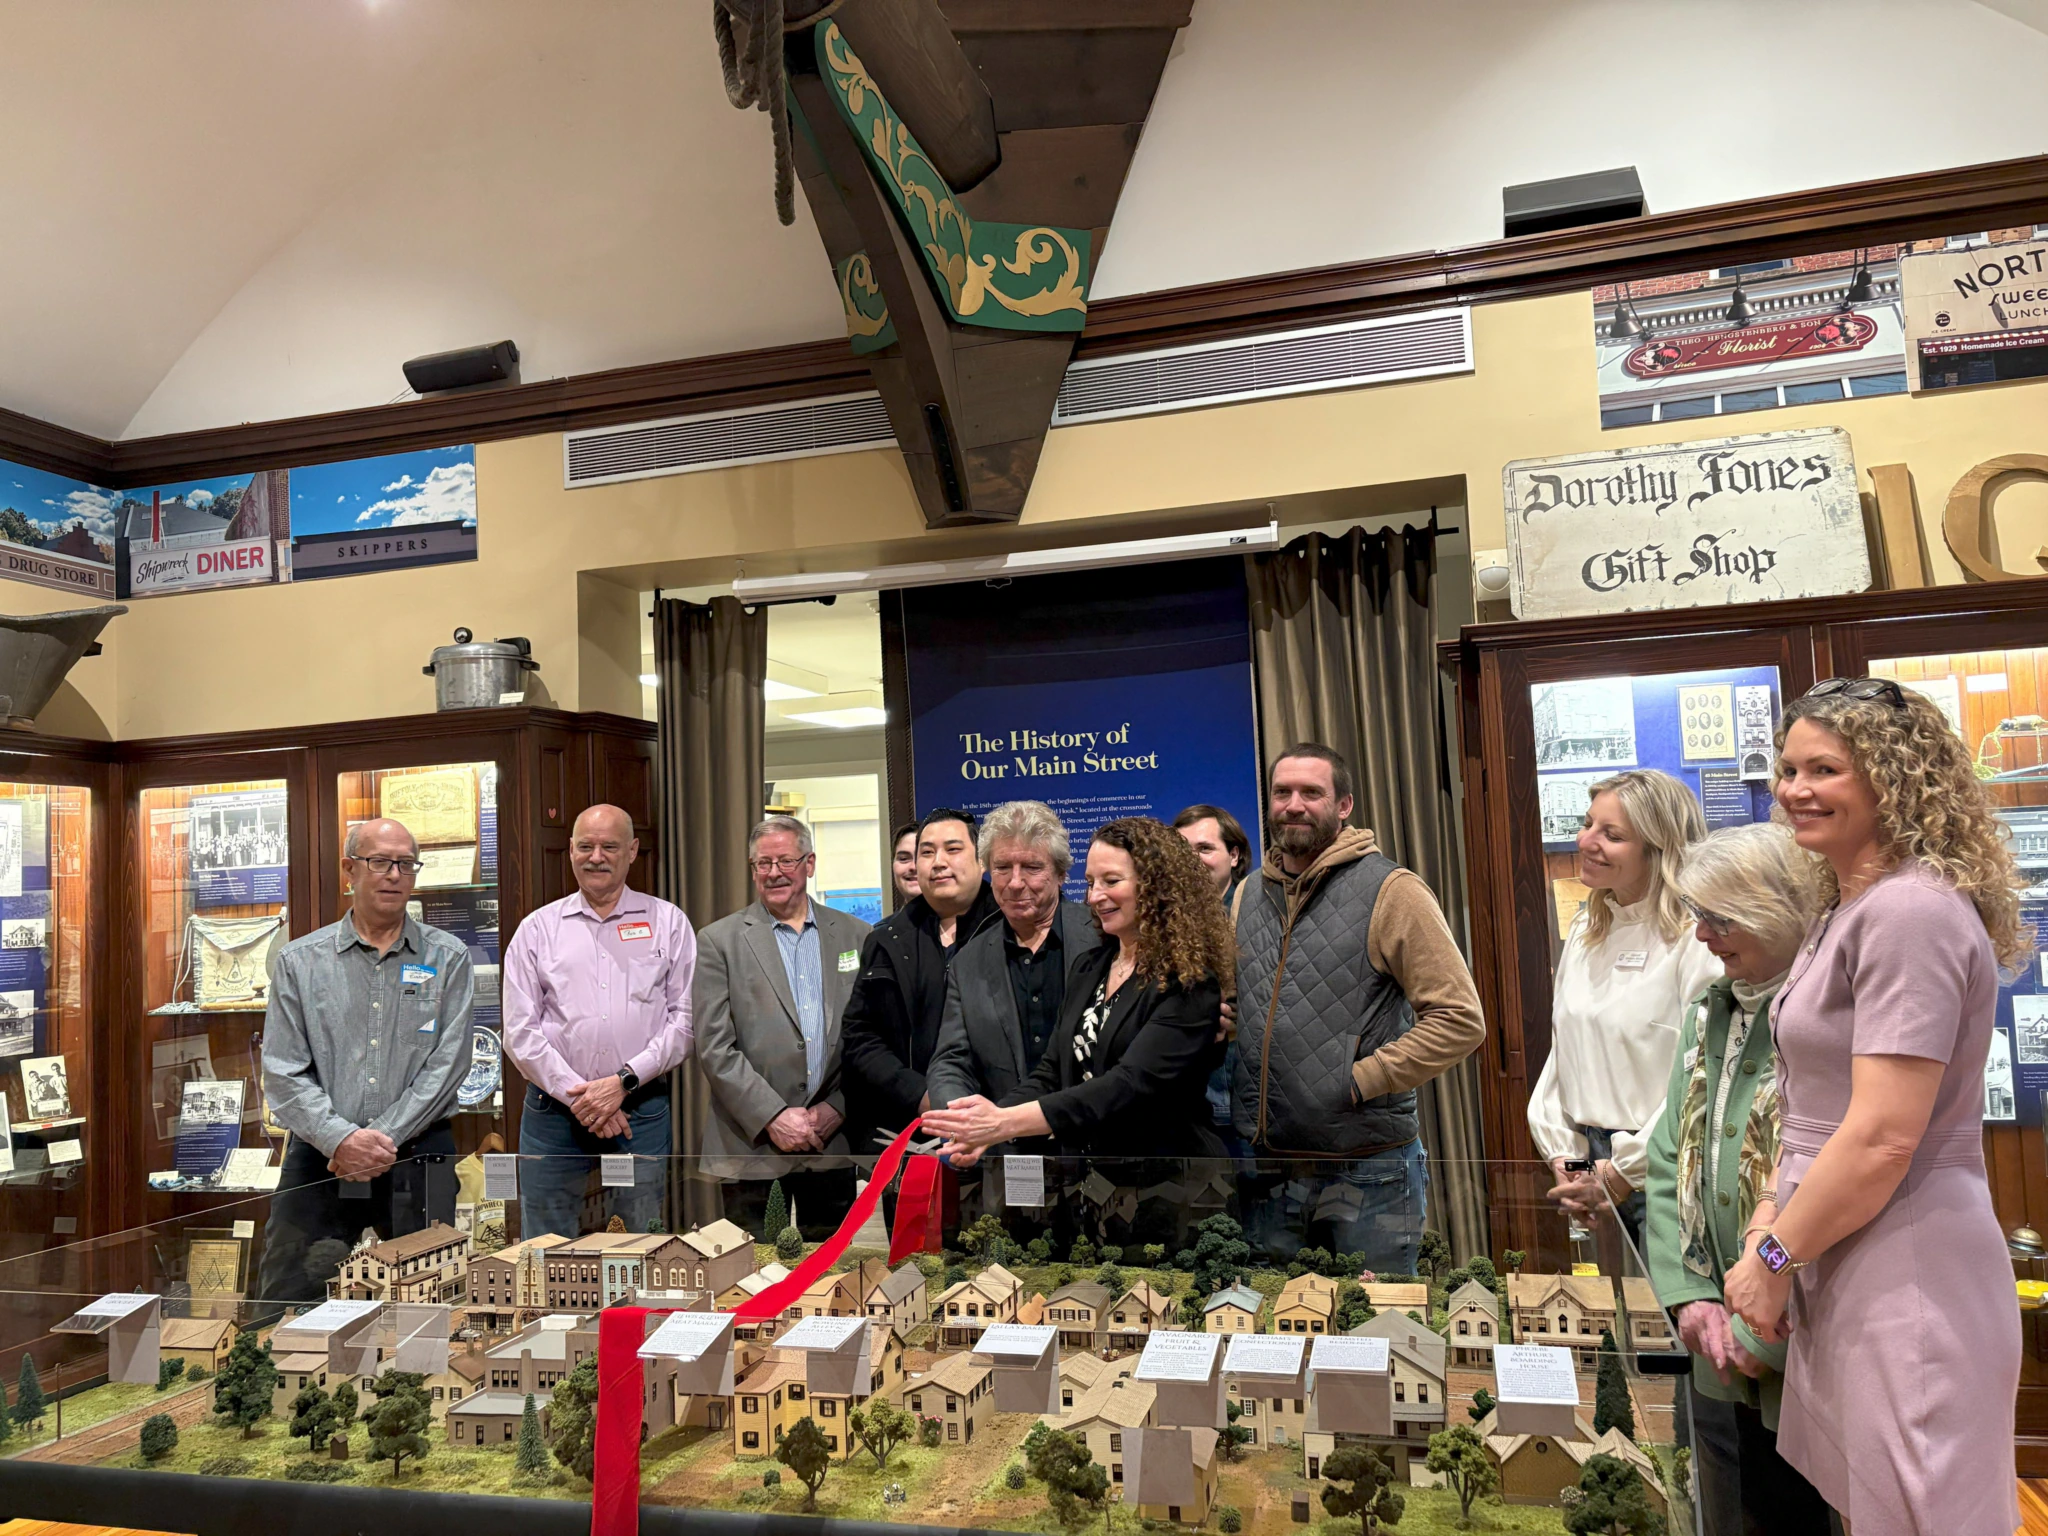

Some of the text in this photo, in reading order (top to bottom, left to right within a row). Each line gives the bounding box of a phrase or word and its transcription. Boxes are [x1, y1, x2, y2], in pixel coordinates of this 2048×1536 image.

[1800, 319, 1822, 329] SON
[1716, 335, 1779, 357] Florist
[1922, 336, 2046, 355] Est. 1929 Homemade Ice Cream
[1522, 449, 1834, 525] Dorothy Jones
[337, 538, 428, 558] SKIPPERS
[9, 556, 96, 586] DRUG STORE
[135, 546, 265, 585] Shipwreck DINER
[1581, 528, 1778, 593] Gift Shop
[959, 722, 1131, 754] The History of
[961, 750, 1160, 781] Our Main Street
[1057, 797, 1089, 806] beginnings
[1090, 795, 1097, 803] of
[1096, 795, 1128, 803] commerce
[1079, 805, 1101, 813] located
[1119, 803, 1153, 811] crossroads
[403, 963, 421, 971] Hello
[1154, 1343, 1208, 1352] VEGETABLES
